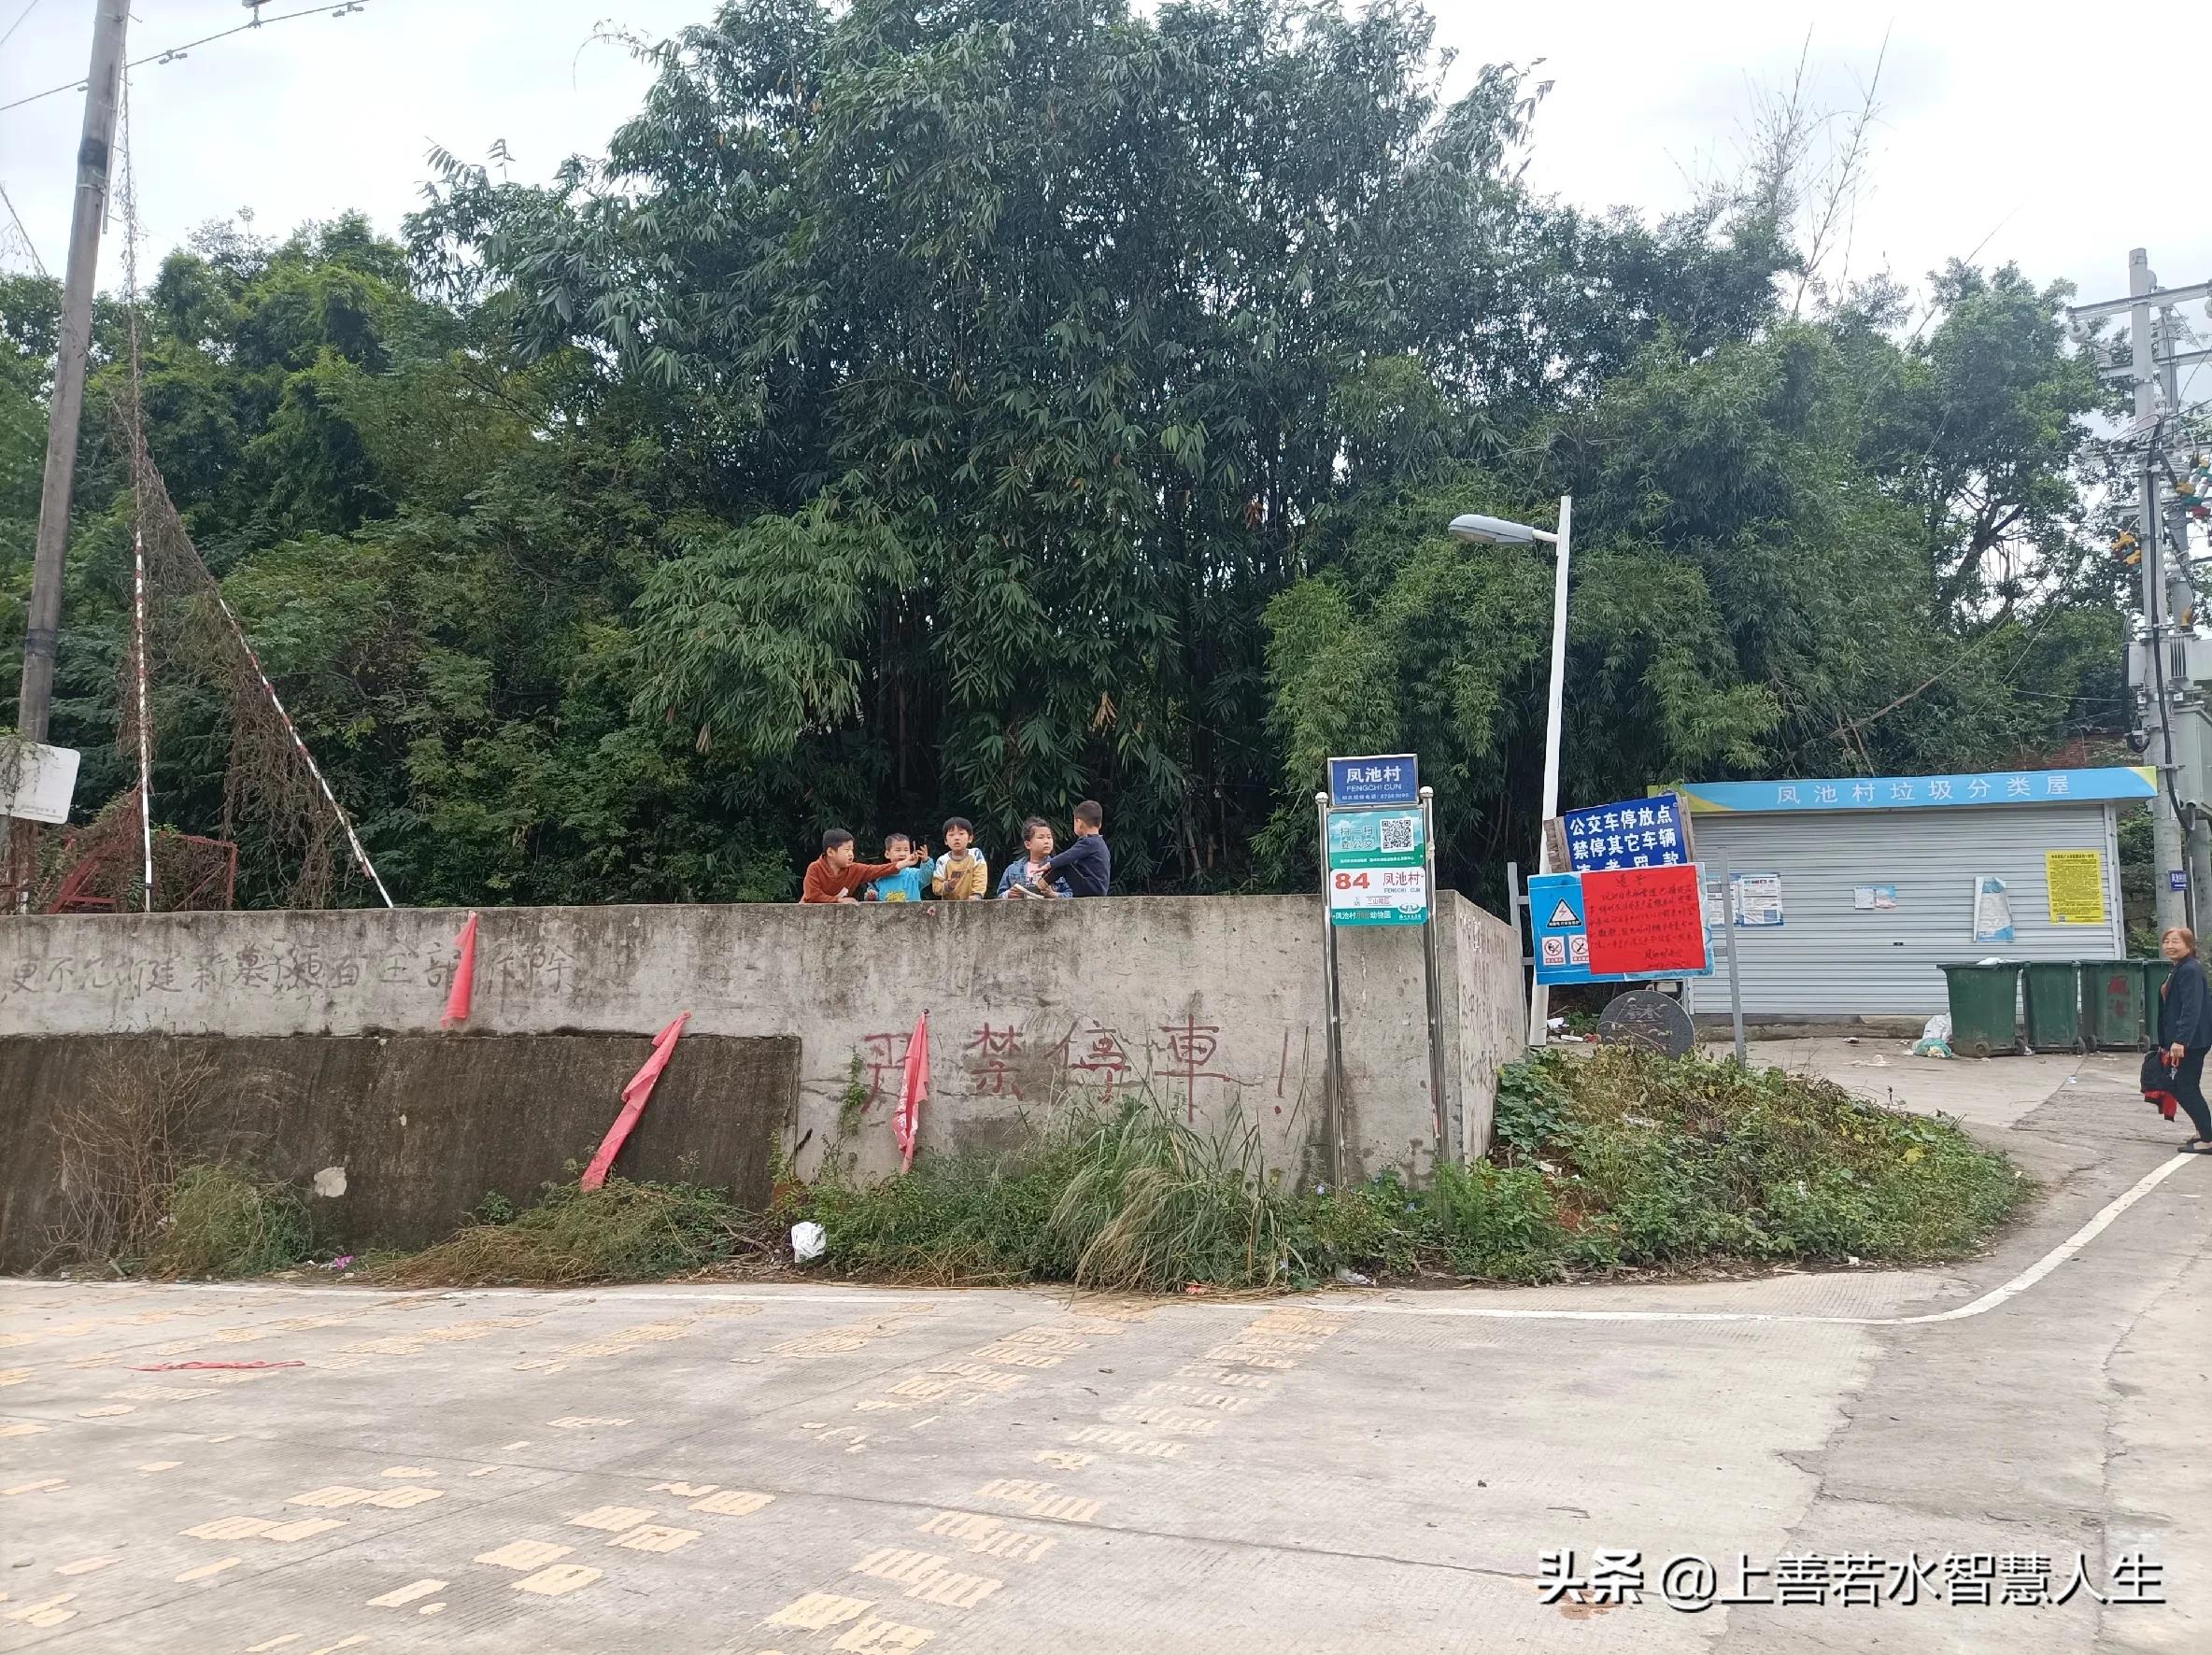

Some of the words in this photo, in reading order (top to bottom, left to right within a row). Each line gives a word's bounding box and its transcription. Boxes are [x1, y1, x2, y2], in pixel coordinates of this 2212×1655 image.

[1346, 765, 1402, 784] 凤池村
[1777, 775, 2071, 805] 凤池村垃圾分类屋
[1569, 804, 1673, 836] 公交车停放点
[1572, 828, 1677, 860] 禁停其它车辆
[1335, 872, 1370, 889] 84
[1382, 871, 1421, 886] 凤池村
